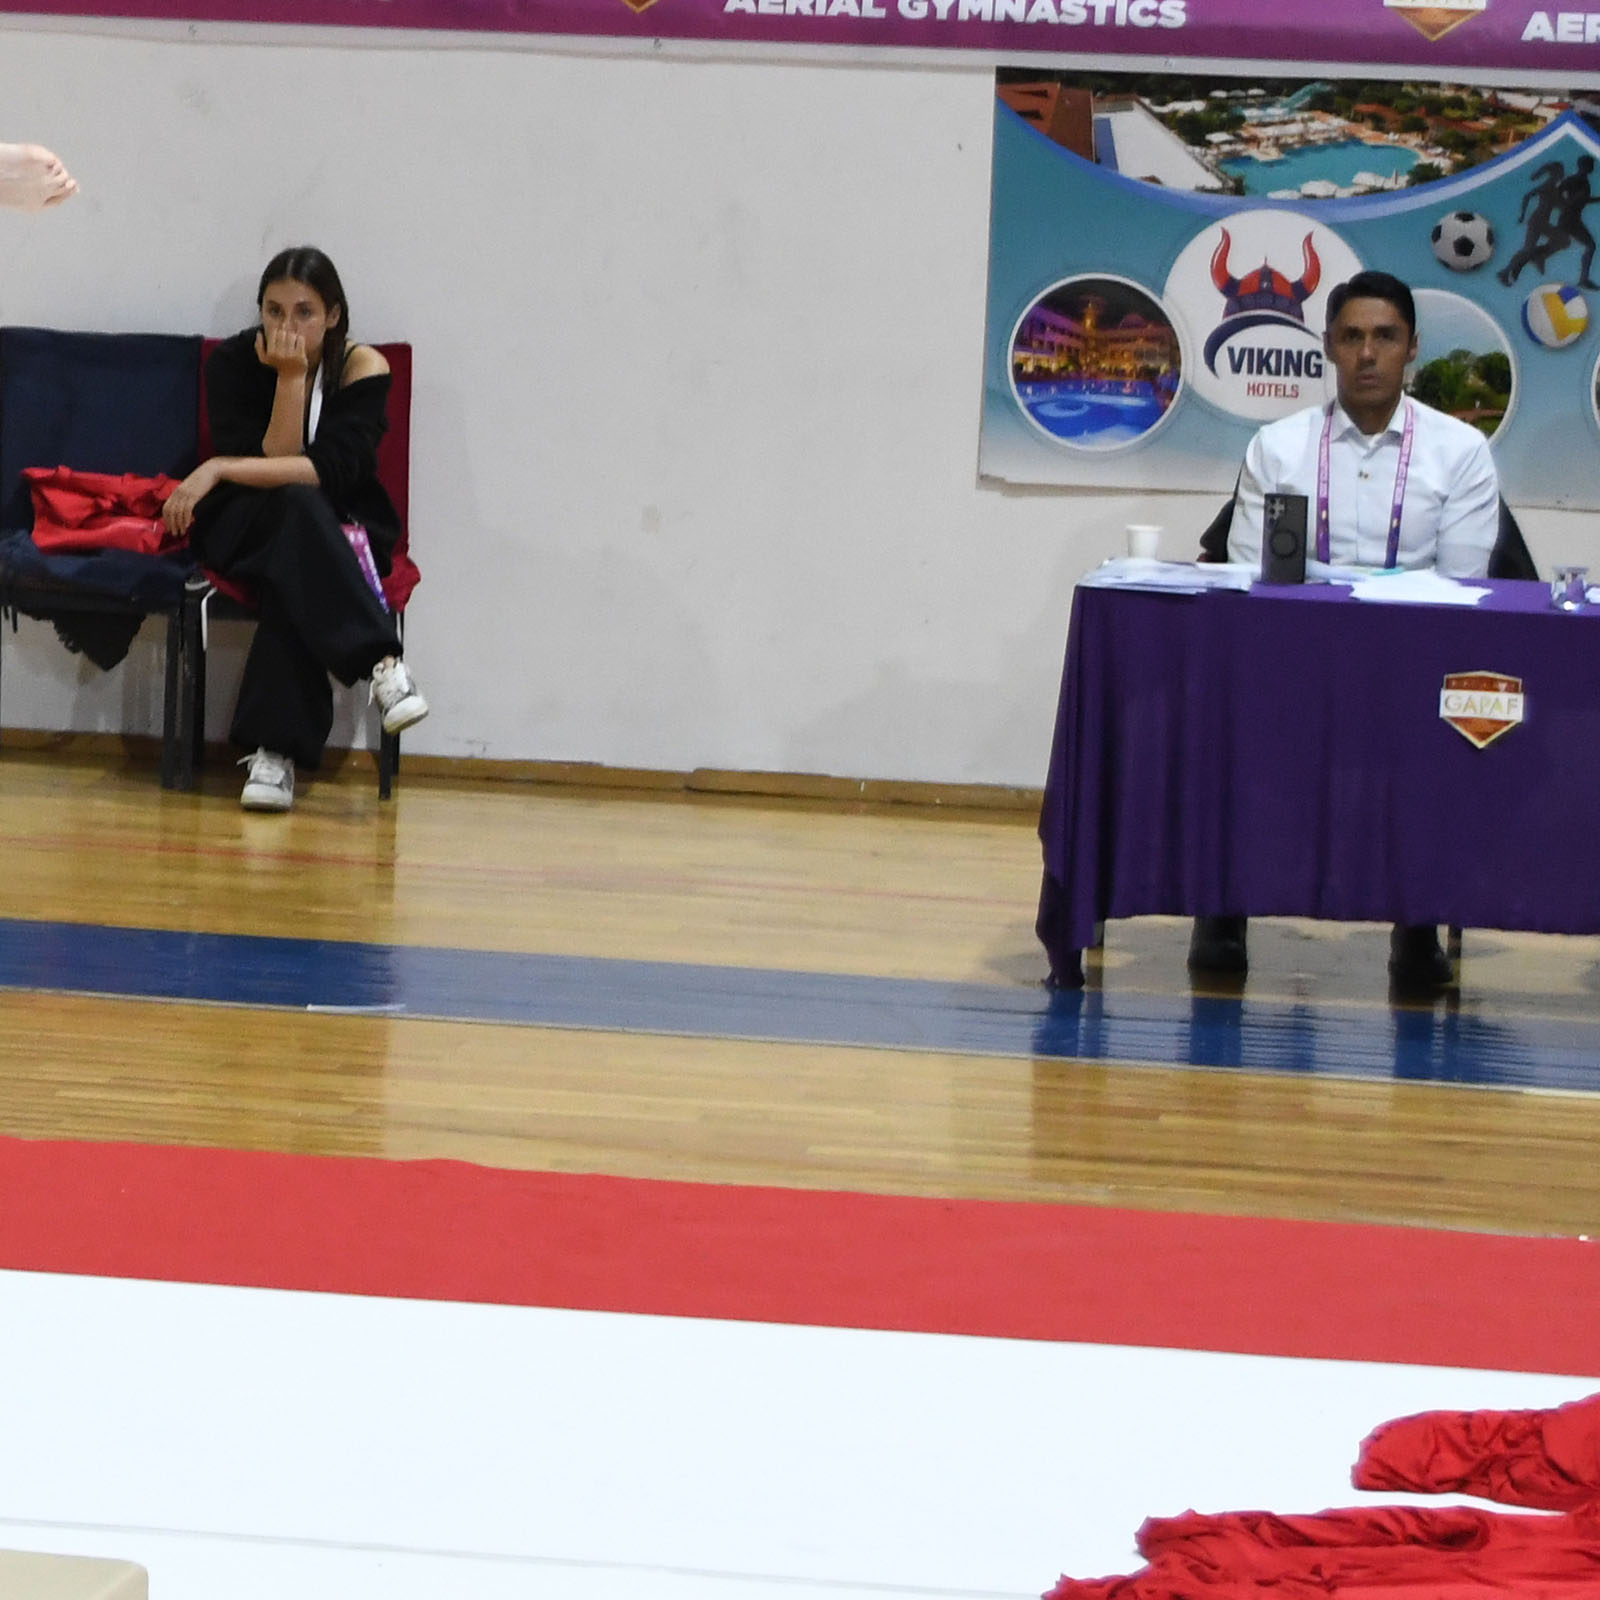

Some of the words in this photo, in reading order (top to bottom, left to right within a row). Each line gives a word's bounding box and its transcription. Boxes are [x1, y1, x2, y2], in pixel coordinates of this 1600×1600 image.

[1226, 346, 1323, 379] VIKING
[1246, 381, 1300, 399] HOTELS
[1443, 693, 1519, 716] GAPAF
